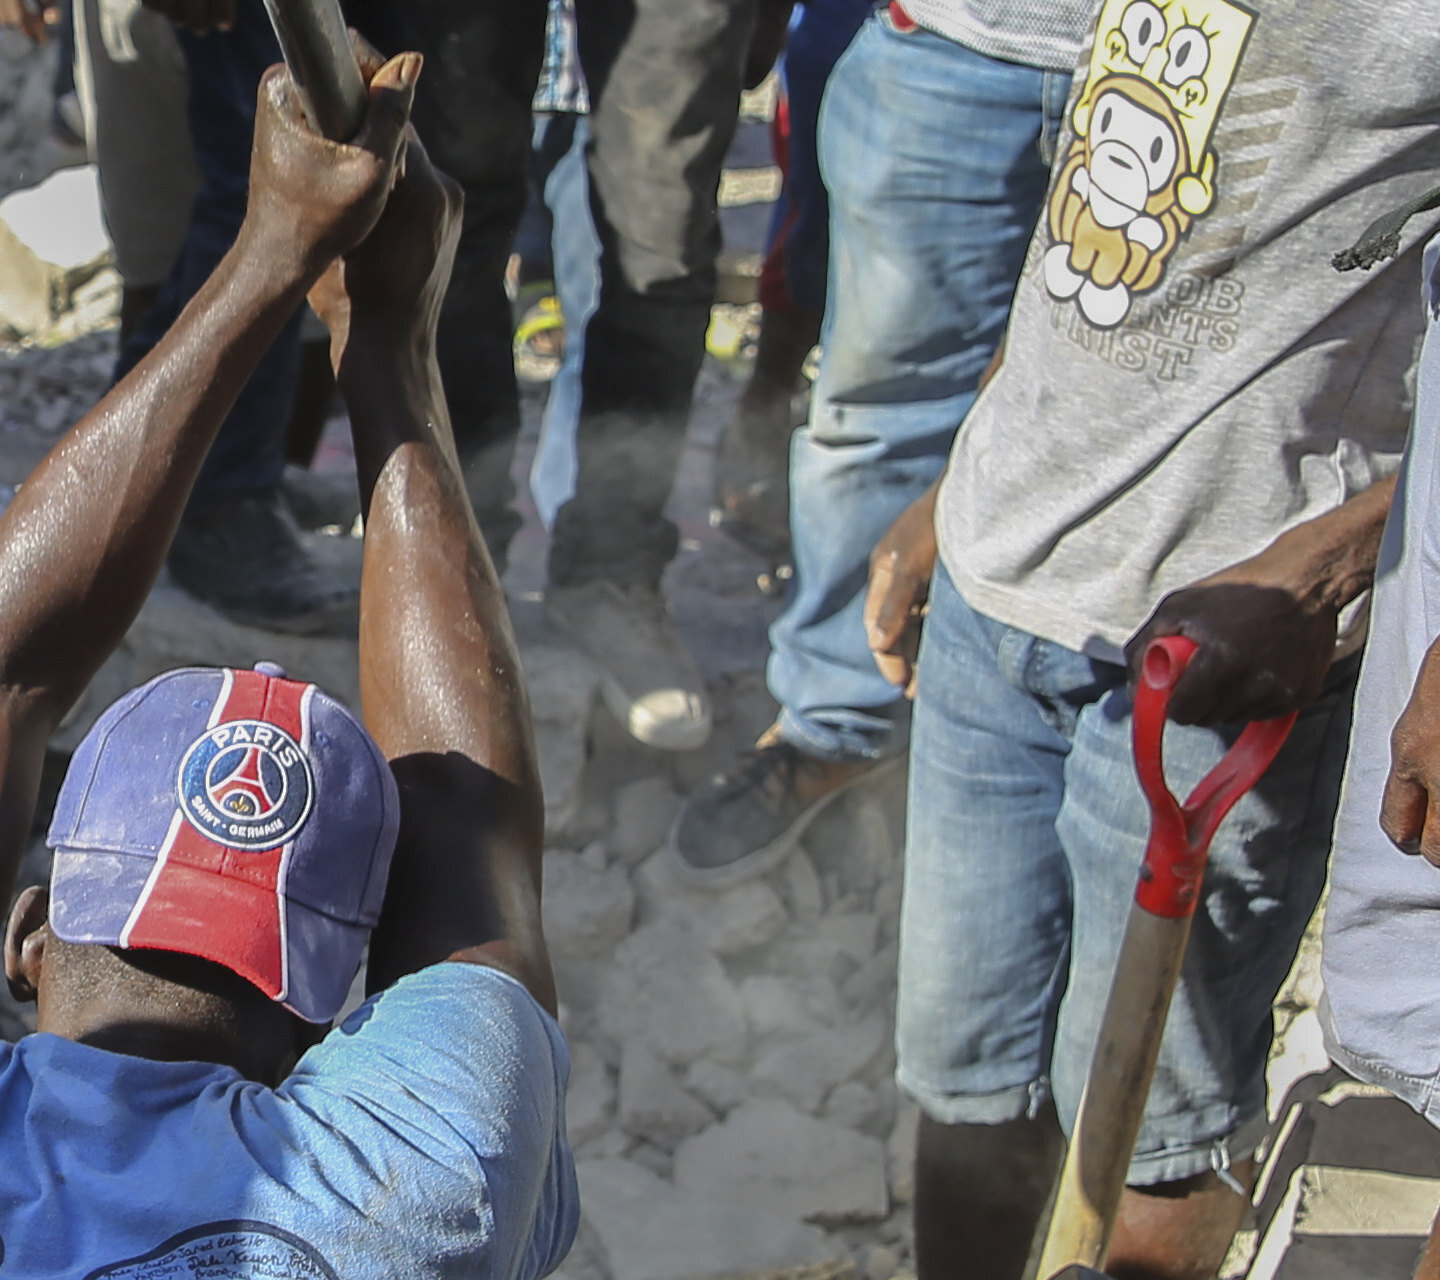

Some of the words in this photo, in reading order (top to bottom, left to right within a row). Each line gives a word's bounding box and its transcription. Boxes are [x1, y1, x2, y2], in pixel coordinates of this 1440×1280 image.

[211, 726, 298, 768] PARIS
[191, 795, 221, 828] SAINT
[228, 818, 286, 838] GERMAIN
